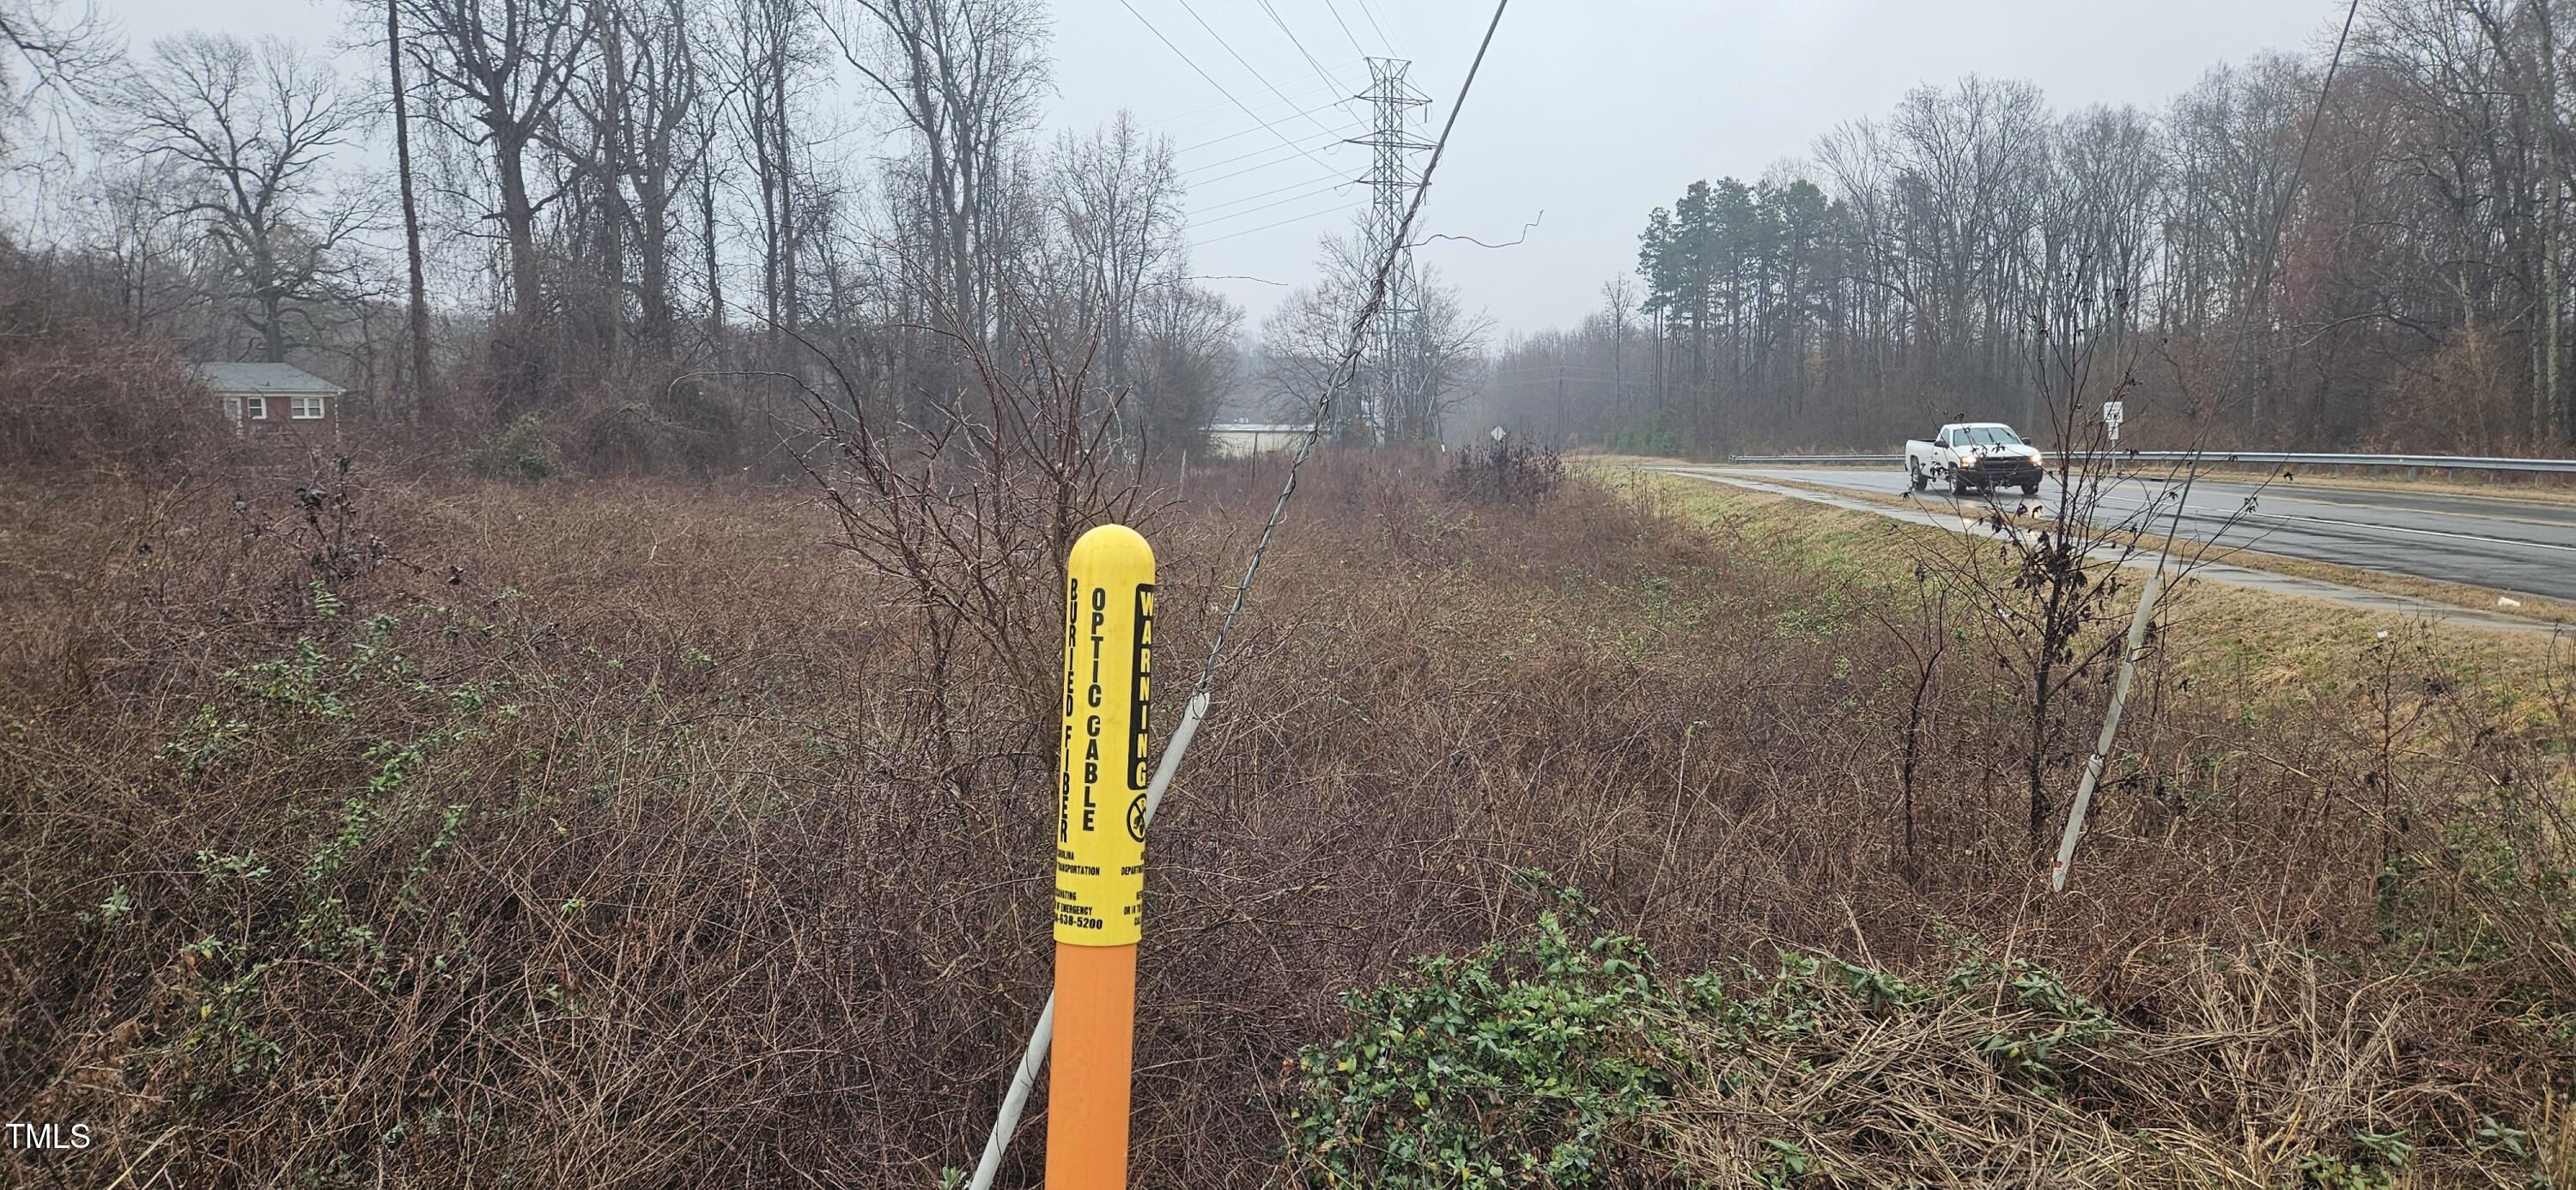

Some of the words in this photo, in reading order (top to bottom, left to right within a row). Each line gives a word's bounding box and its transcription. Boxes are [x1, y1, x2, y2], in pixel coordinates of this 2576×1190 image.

[1066, 578, 1078, 717] BURIED
[1088, 587, 1106, 707] OPTIC
[1136, 591, 1154, 787] WARNING
[1060, 726, 1072, 843] FIBER
[1083, 715, 1101, 831] CABLE
[1061, 903, 1092, 915] EMERGENCY
